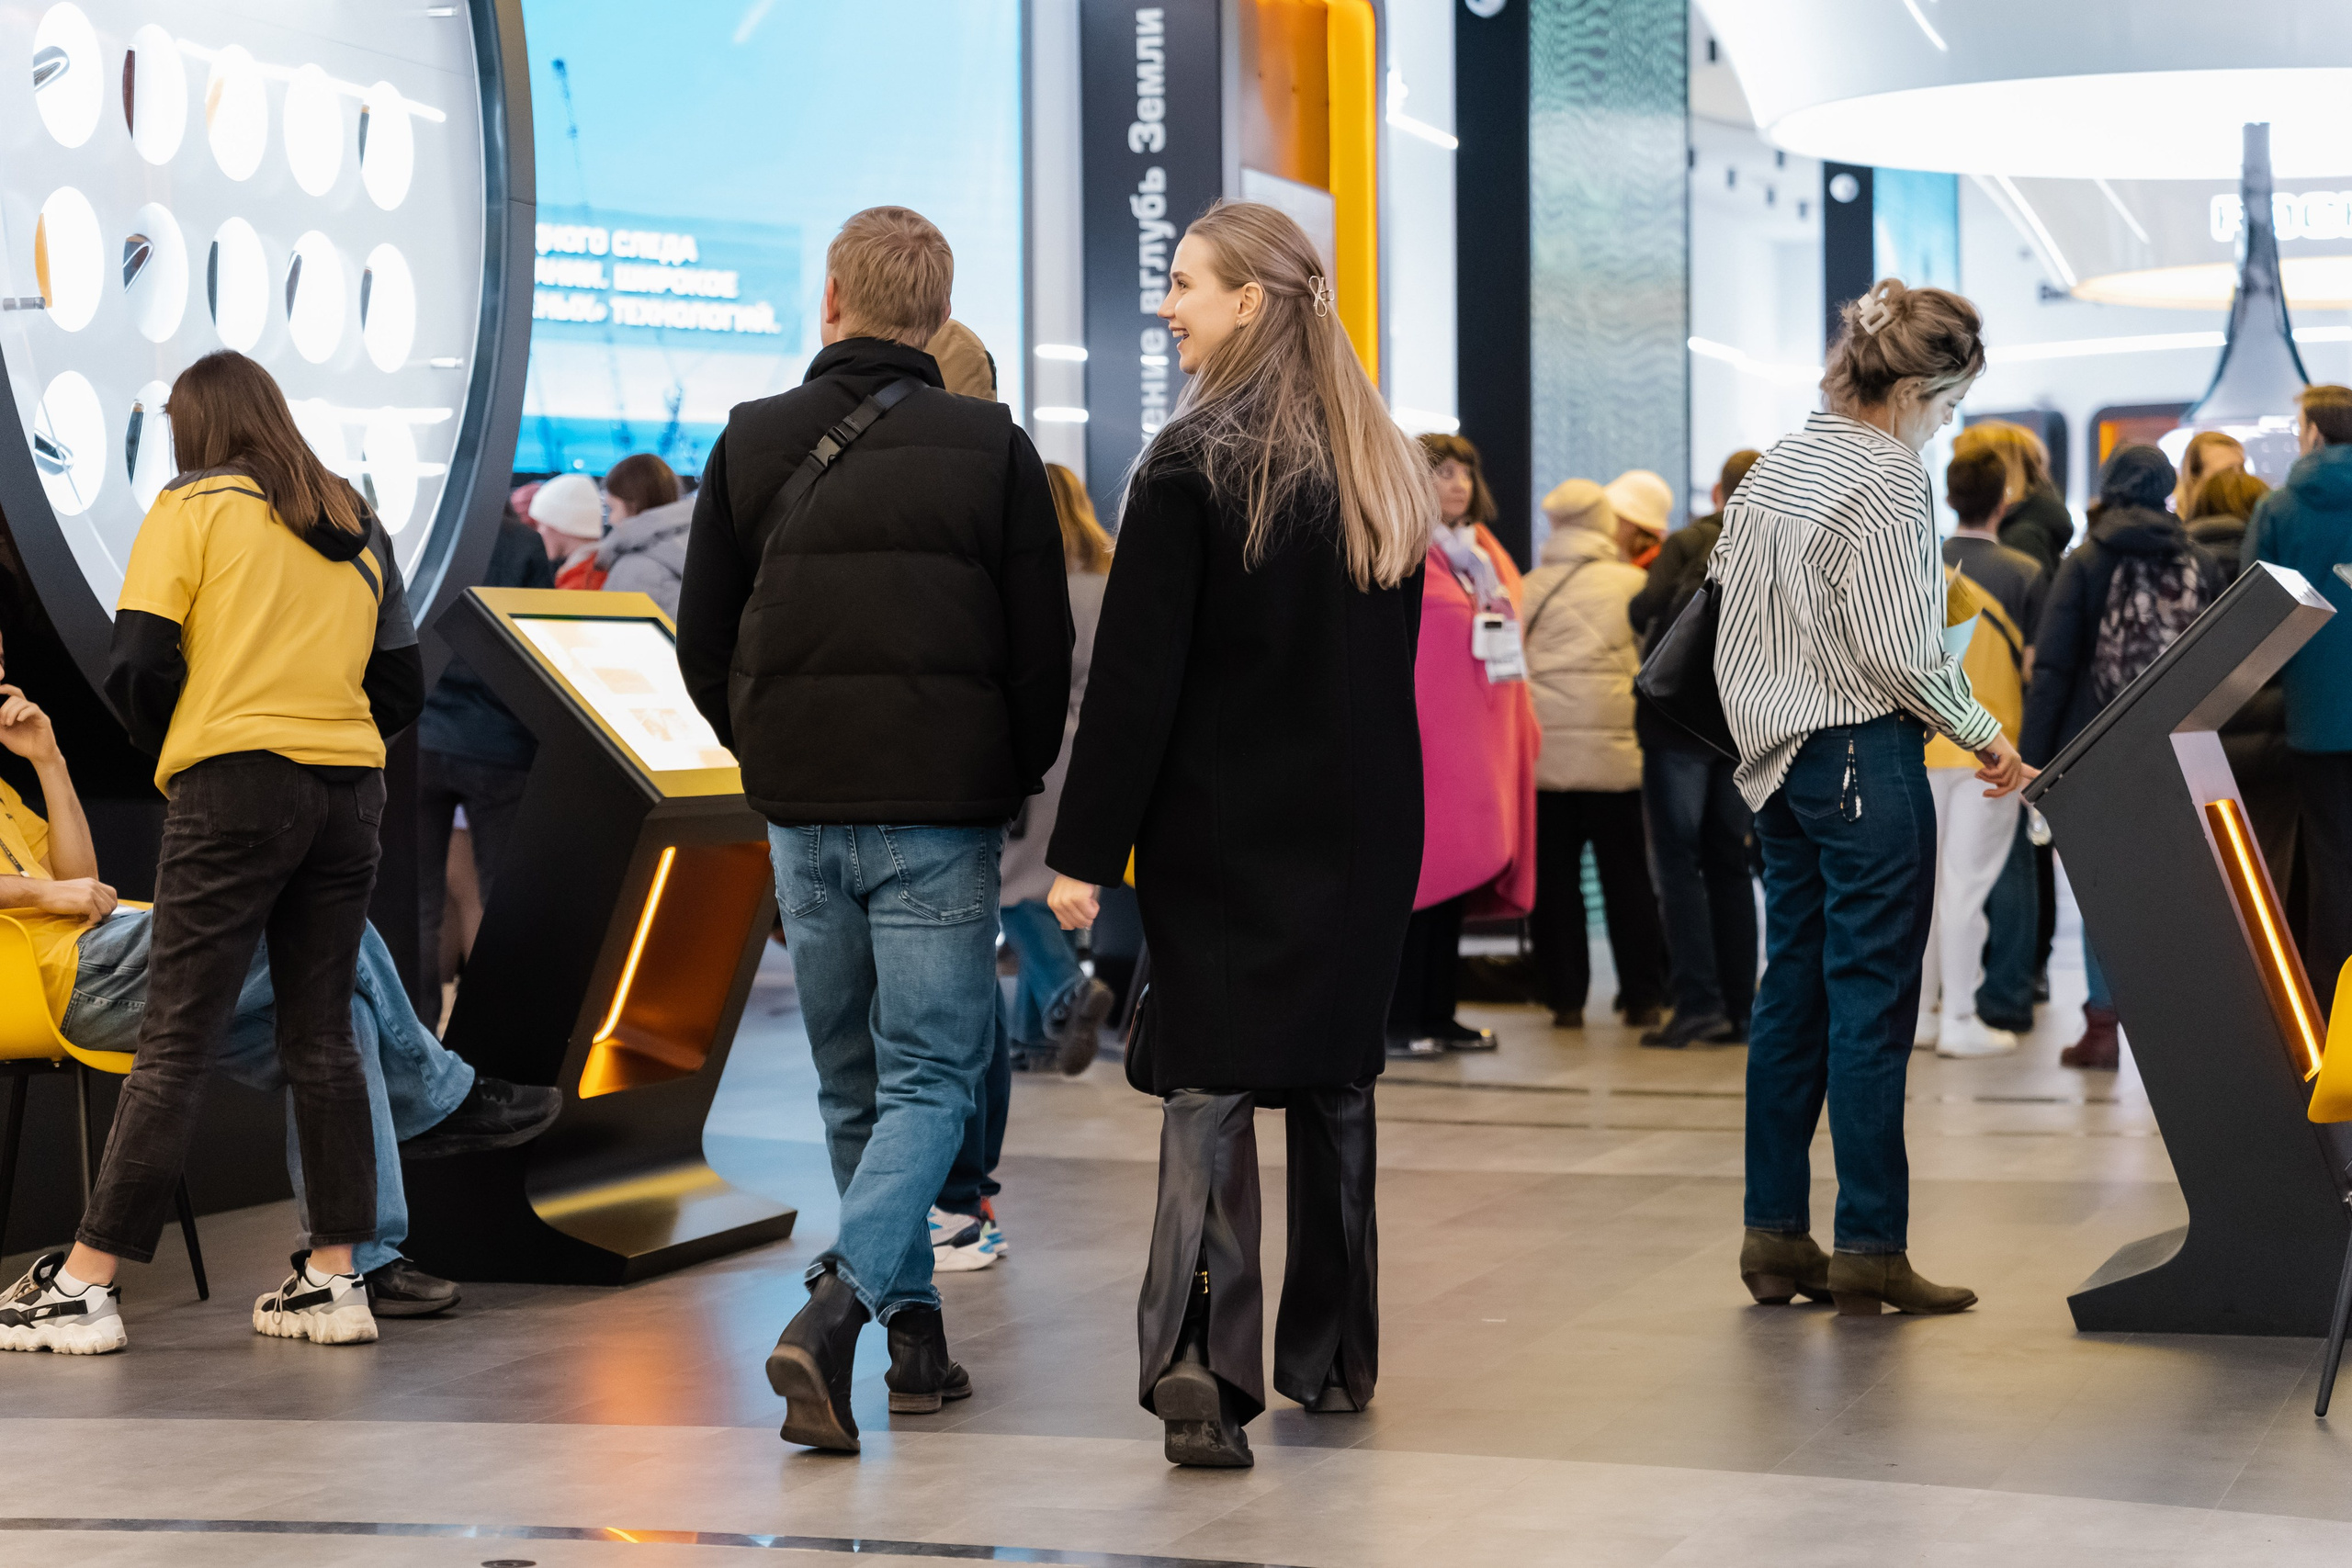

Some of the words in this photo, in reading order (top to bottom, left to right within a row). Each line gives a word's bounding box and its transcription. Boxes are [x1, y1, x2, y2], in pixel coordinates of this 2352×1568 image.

[1128, 6, 1166, 154] Земли
[1130, 166, 1176, 316] вглубь
[1140, 327, 1170, 444] ение
